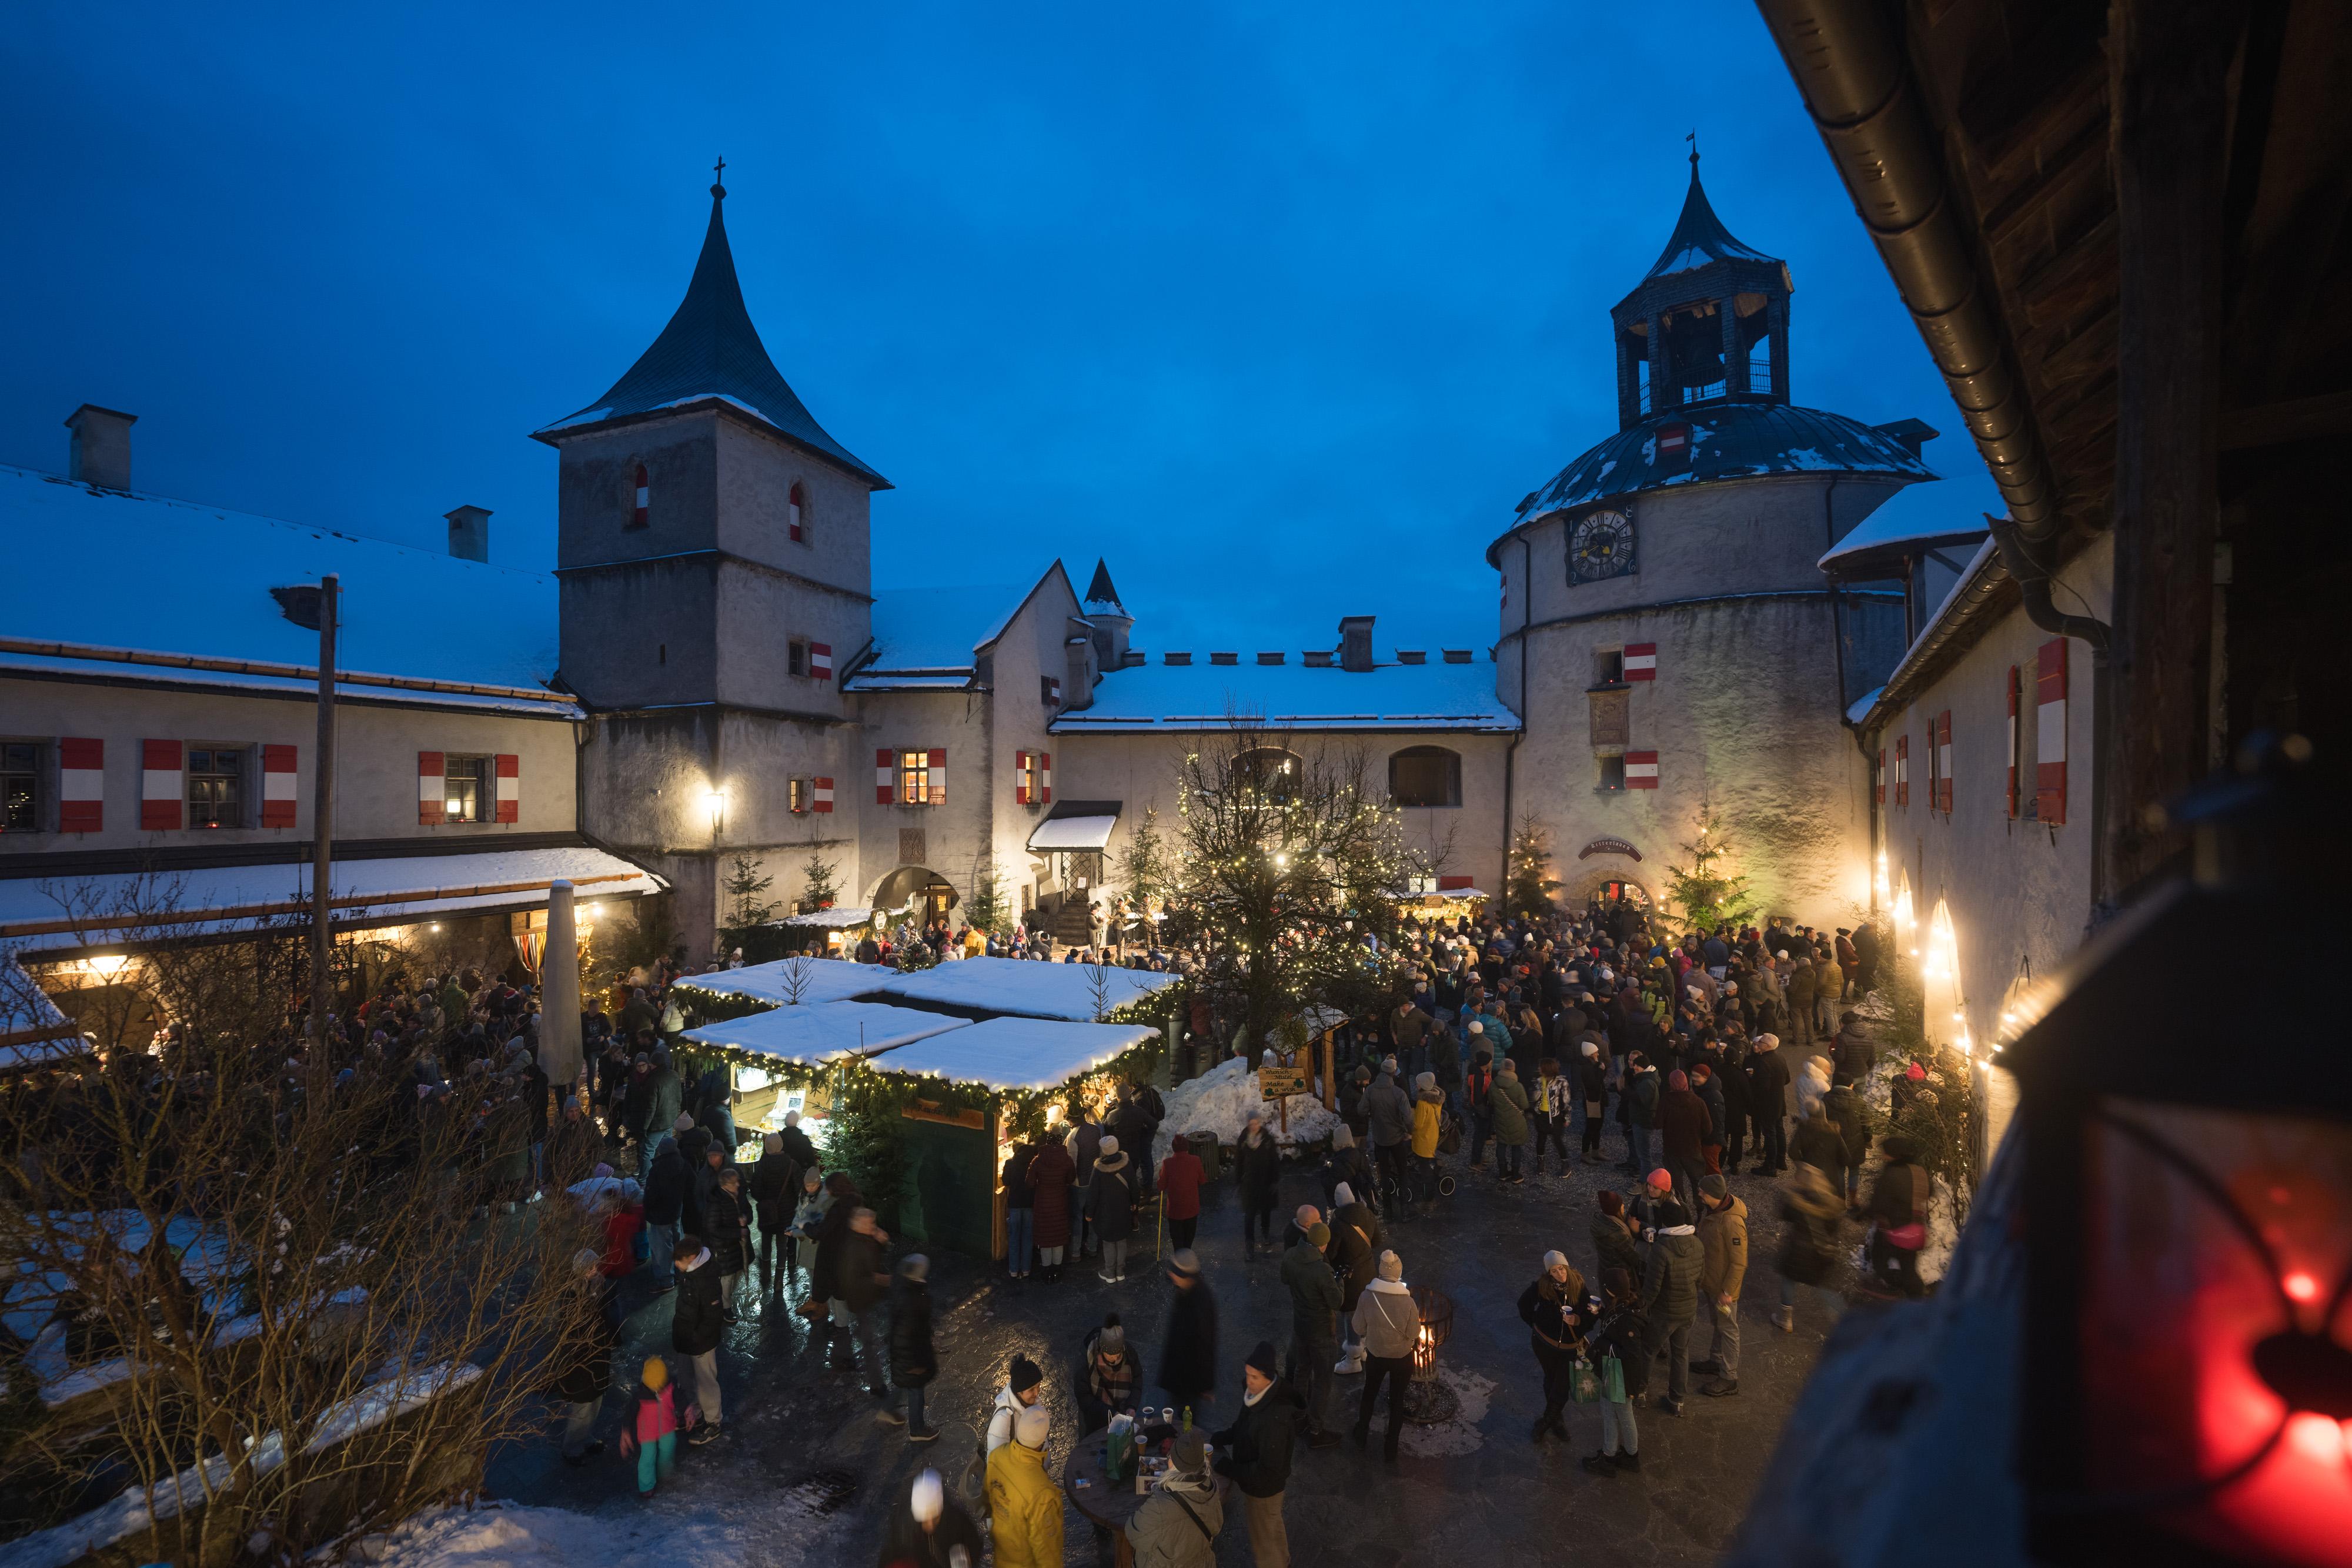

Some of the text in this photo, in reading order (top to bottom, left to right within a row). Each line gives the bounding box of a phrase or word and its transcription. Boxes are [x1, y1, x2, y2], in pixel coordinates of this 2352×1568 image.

[1626, 504, 1633, 518] 8
[1628, 559, 1636, 573] 6
[1591, 841, 1630, 851] Ritterladen
